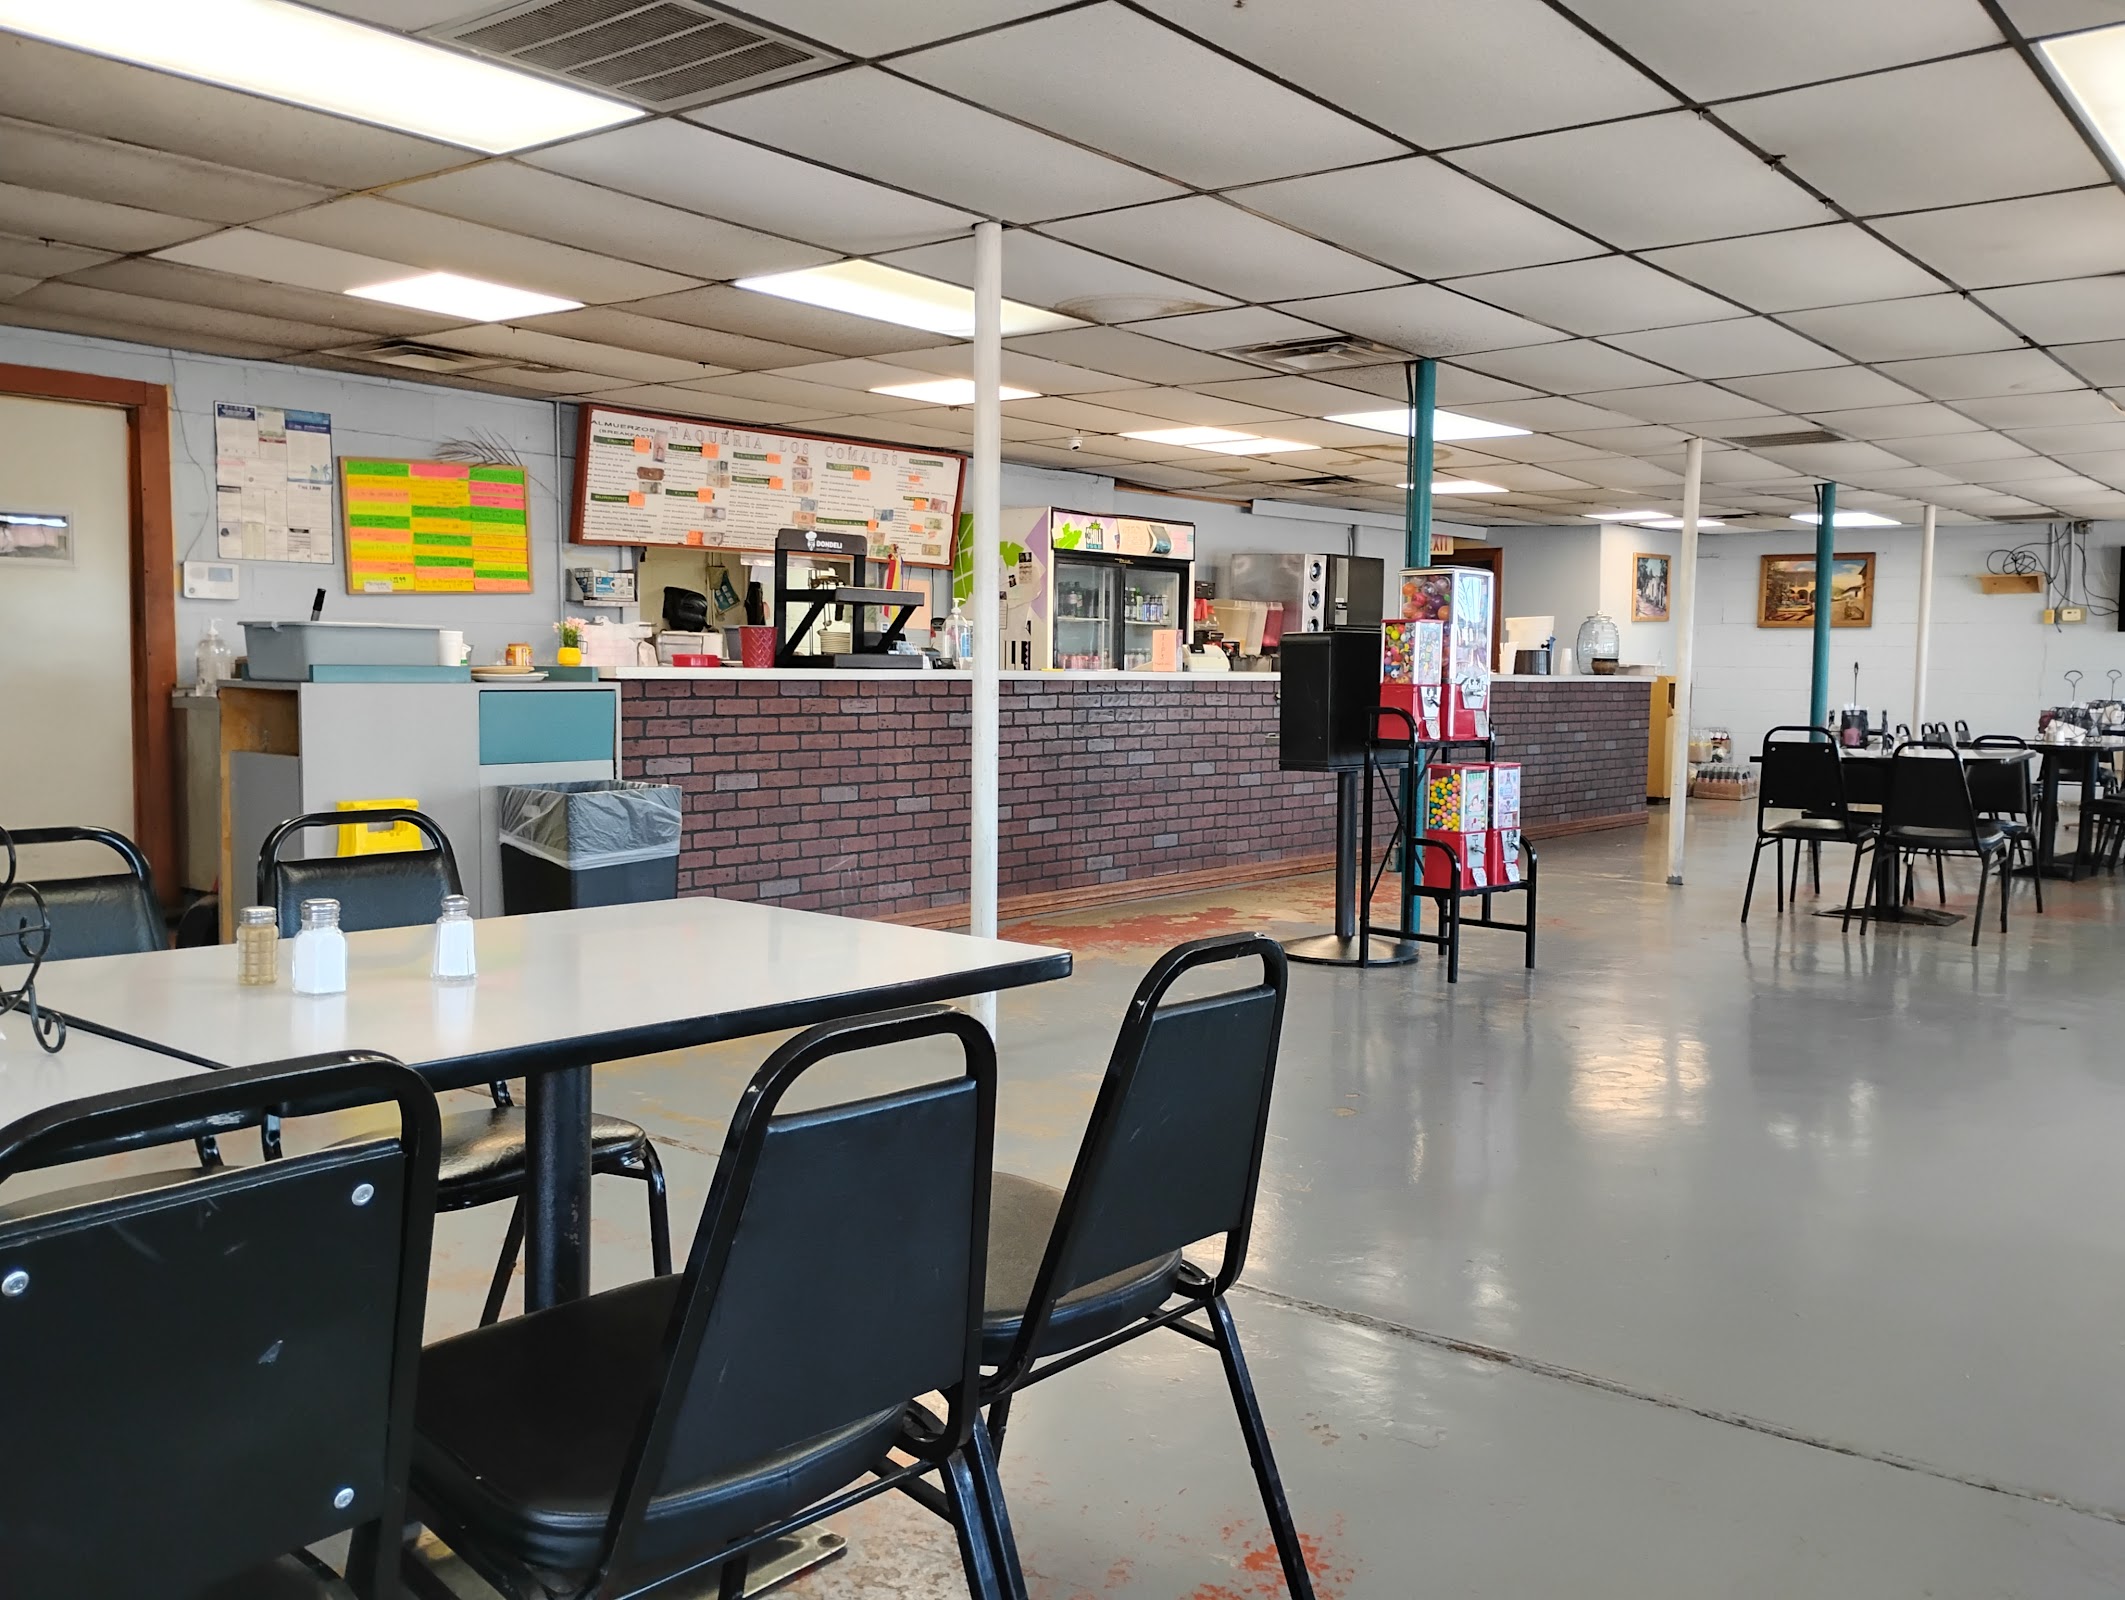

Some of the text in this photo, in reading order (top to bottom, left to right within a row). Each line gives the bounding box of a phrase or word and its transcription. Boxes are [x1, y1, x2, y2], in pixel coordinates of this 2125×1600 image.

[591, 419, 656, 433] ALMUERZOS
[598, 428, 654, 439] (BREAKFAST)
[670, 426, 898, 466] TAQUERIA LOS COMALES
[816, 540, 843, 549] DONDELI
[1431, 537, 1448, 552] XIT
